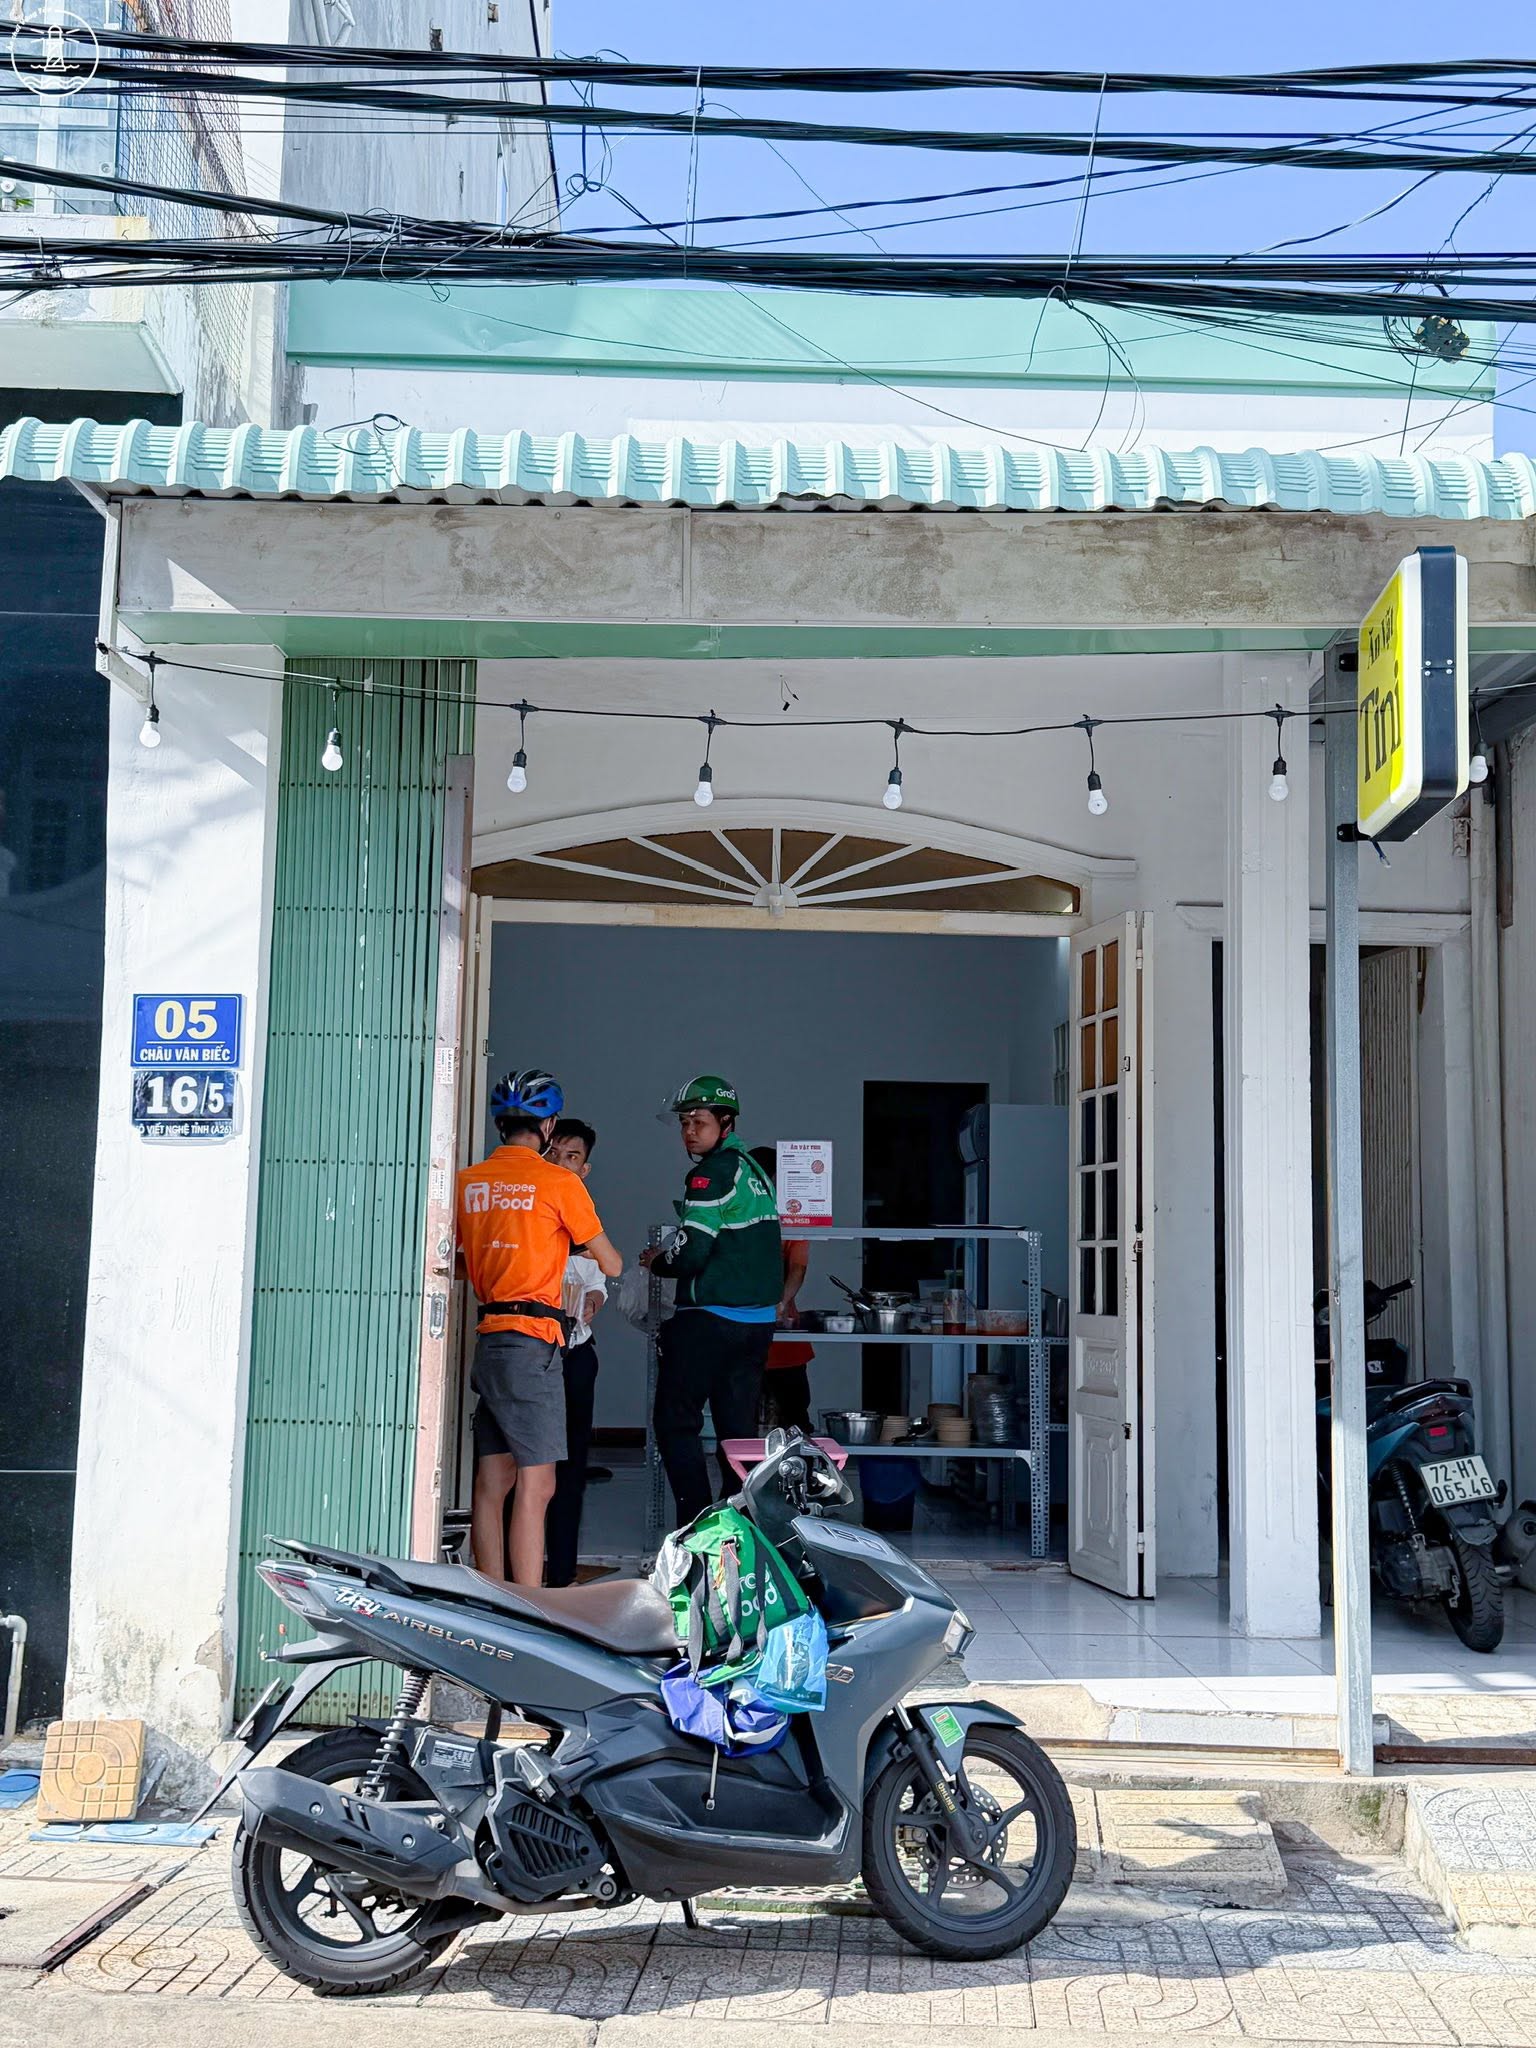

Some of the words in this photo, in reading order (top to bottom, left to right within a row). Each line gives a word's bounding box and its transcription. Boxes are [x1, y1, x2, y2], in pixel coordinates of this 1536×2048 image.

[1367, 628, 1380, 670] Ăn
[1360, 659, 1401, 783] Tini
[154, 1000, 218, 1040] 05
[140, 1046, 172, 1061] CHÂU
[175, 1046, 199, 1061] VĂN
[202, 1045, 231, 1061] BIẾC
[146, 1075, 225, 1115] 16/5
[165, 1123, 190, 1136] NGHỆ
[492, 1181, 537, 1195] Shopee
[491, 1194, 535, 1211] Food
[1429, 1458, 1479, 1484] 72-H1
[1431, 1477, 1493, 1504] 065.46
[383, 1611, 515, 1662] AIRBLADE
